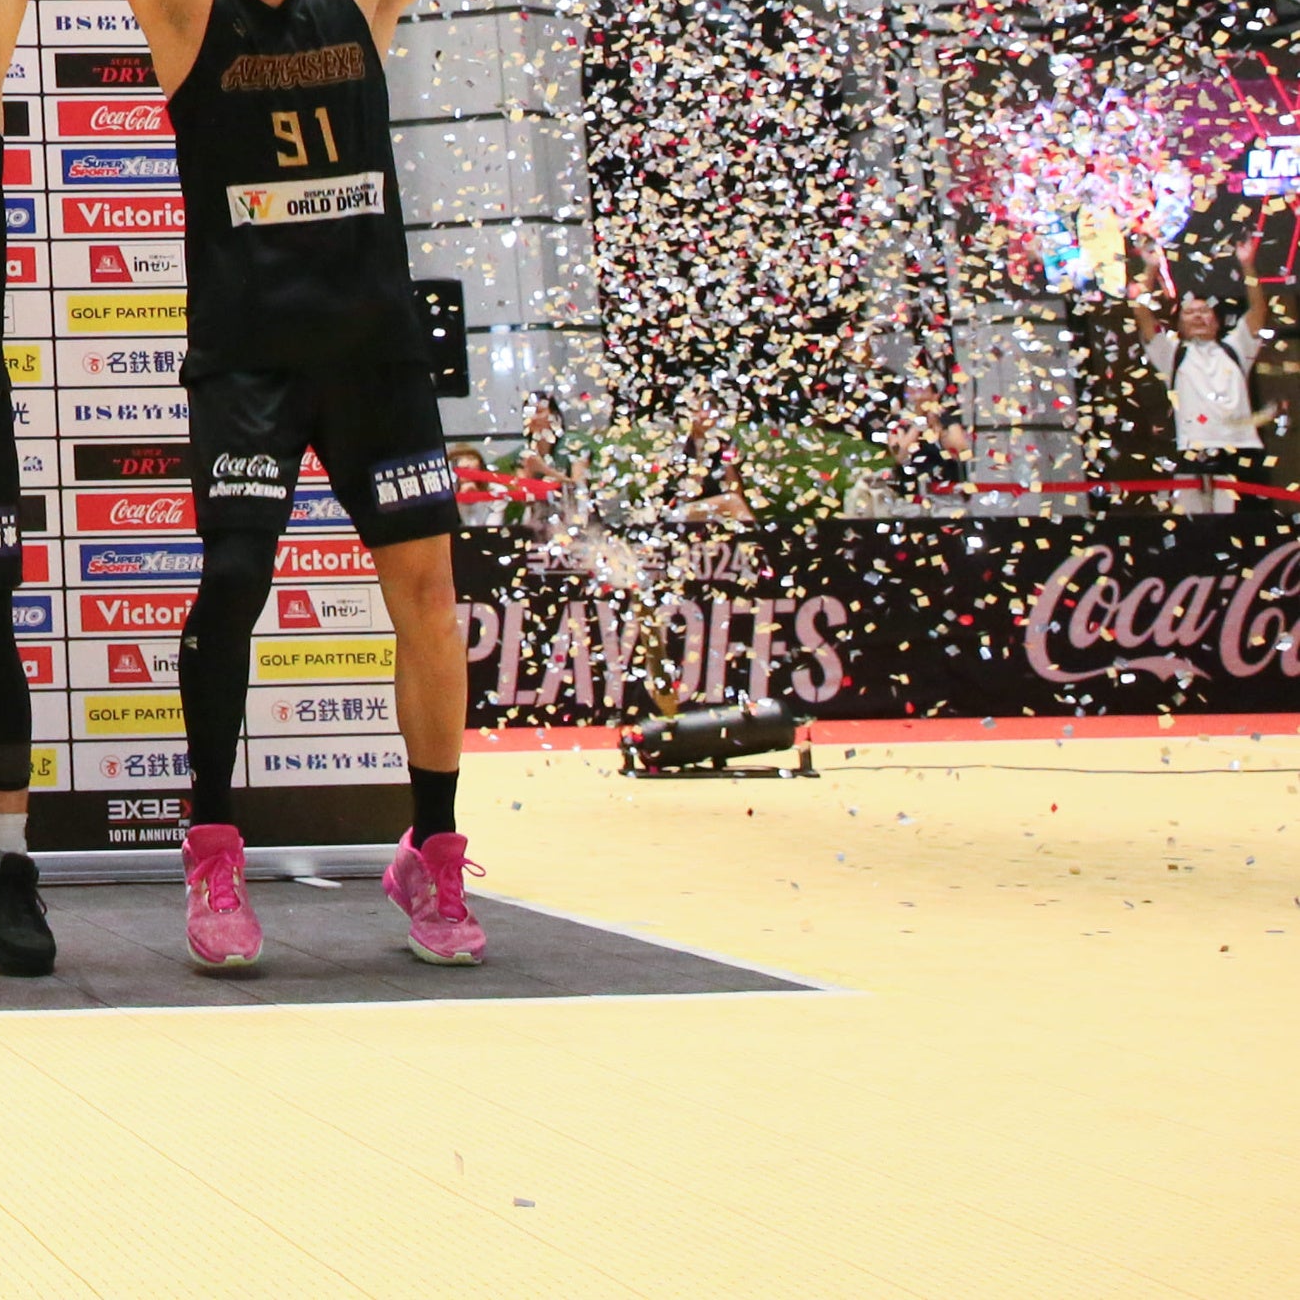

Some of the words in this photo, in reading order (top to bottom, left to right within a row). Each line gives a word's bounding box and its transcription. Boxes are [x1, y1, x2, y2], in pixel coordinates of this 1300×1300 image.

[90, 105, 164, 131] Coca-Cola
[271, 106, 339, 168] 91
[70, 307, 111, 319] GOLF
[116, 306, 188, 319] PARTNER
[109, 498, 187, 525] Coca-Cola
[260, 653, 300, 666] GOLF
[304, 652, 377, 665] PARTNER
[88, 709, 130, 721] GOLF
[295, 697, 389, 722] 名鉄観光
[108, 829, 136, 843] 10TH
